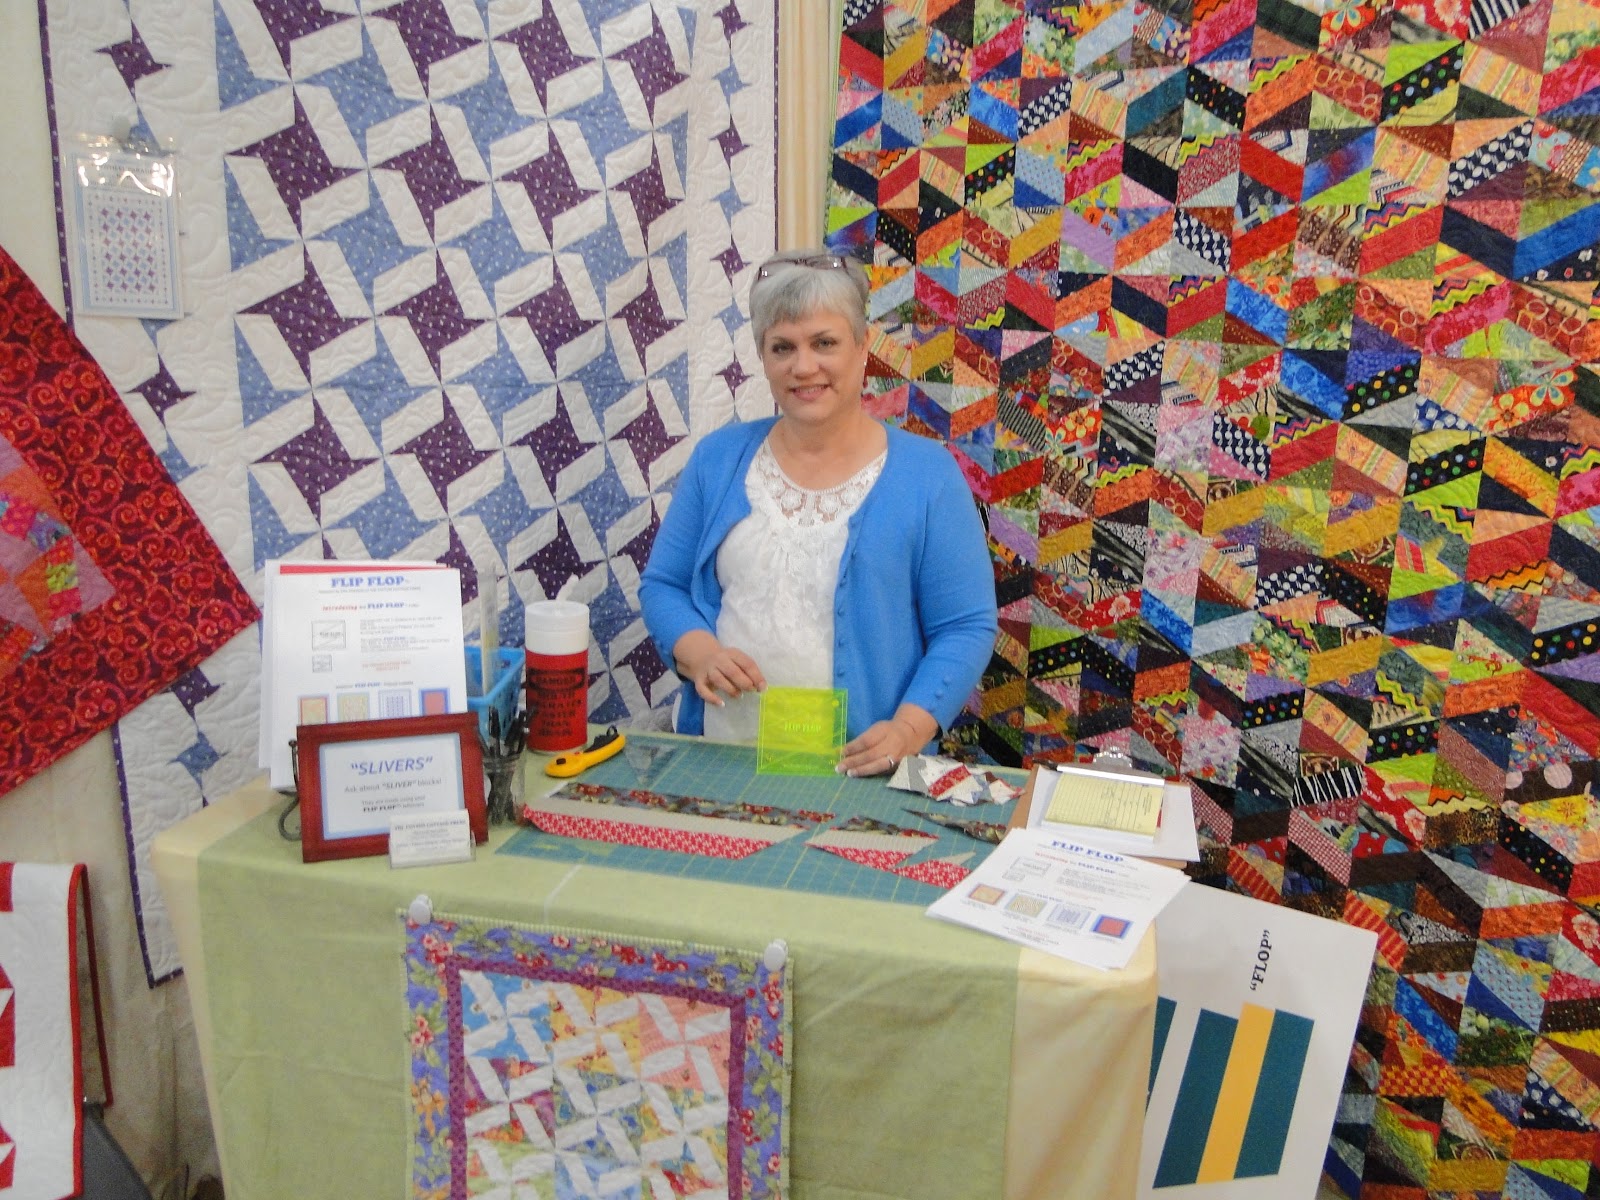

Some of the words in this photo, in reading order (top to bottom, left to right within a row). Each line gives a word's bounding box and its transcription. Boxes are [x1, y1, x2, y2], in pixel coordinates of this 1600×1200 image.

[331, 577, 364, 588] FLIP
[367, 575, 405, 586] FLOP
[351, 755, 434, 776] “SLIVERS”
[344, 785, 357, 793] Ask
[359, 783, 380, 792] about
[1052, 840, 1084, 853] FLIP
[1086, 848, 1124, 863] FLOP
[1249, 929, 1272, 991] “FLOP”
